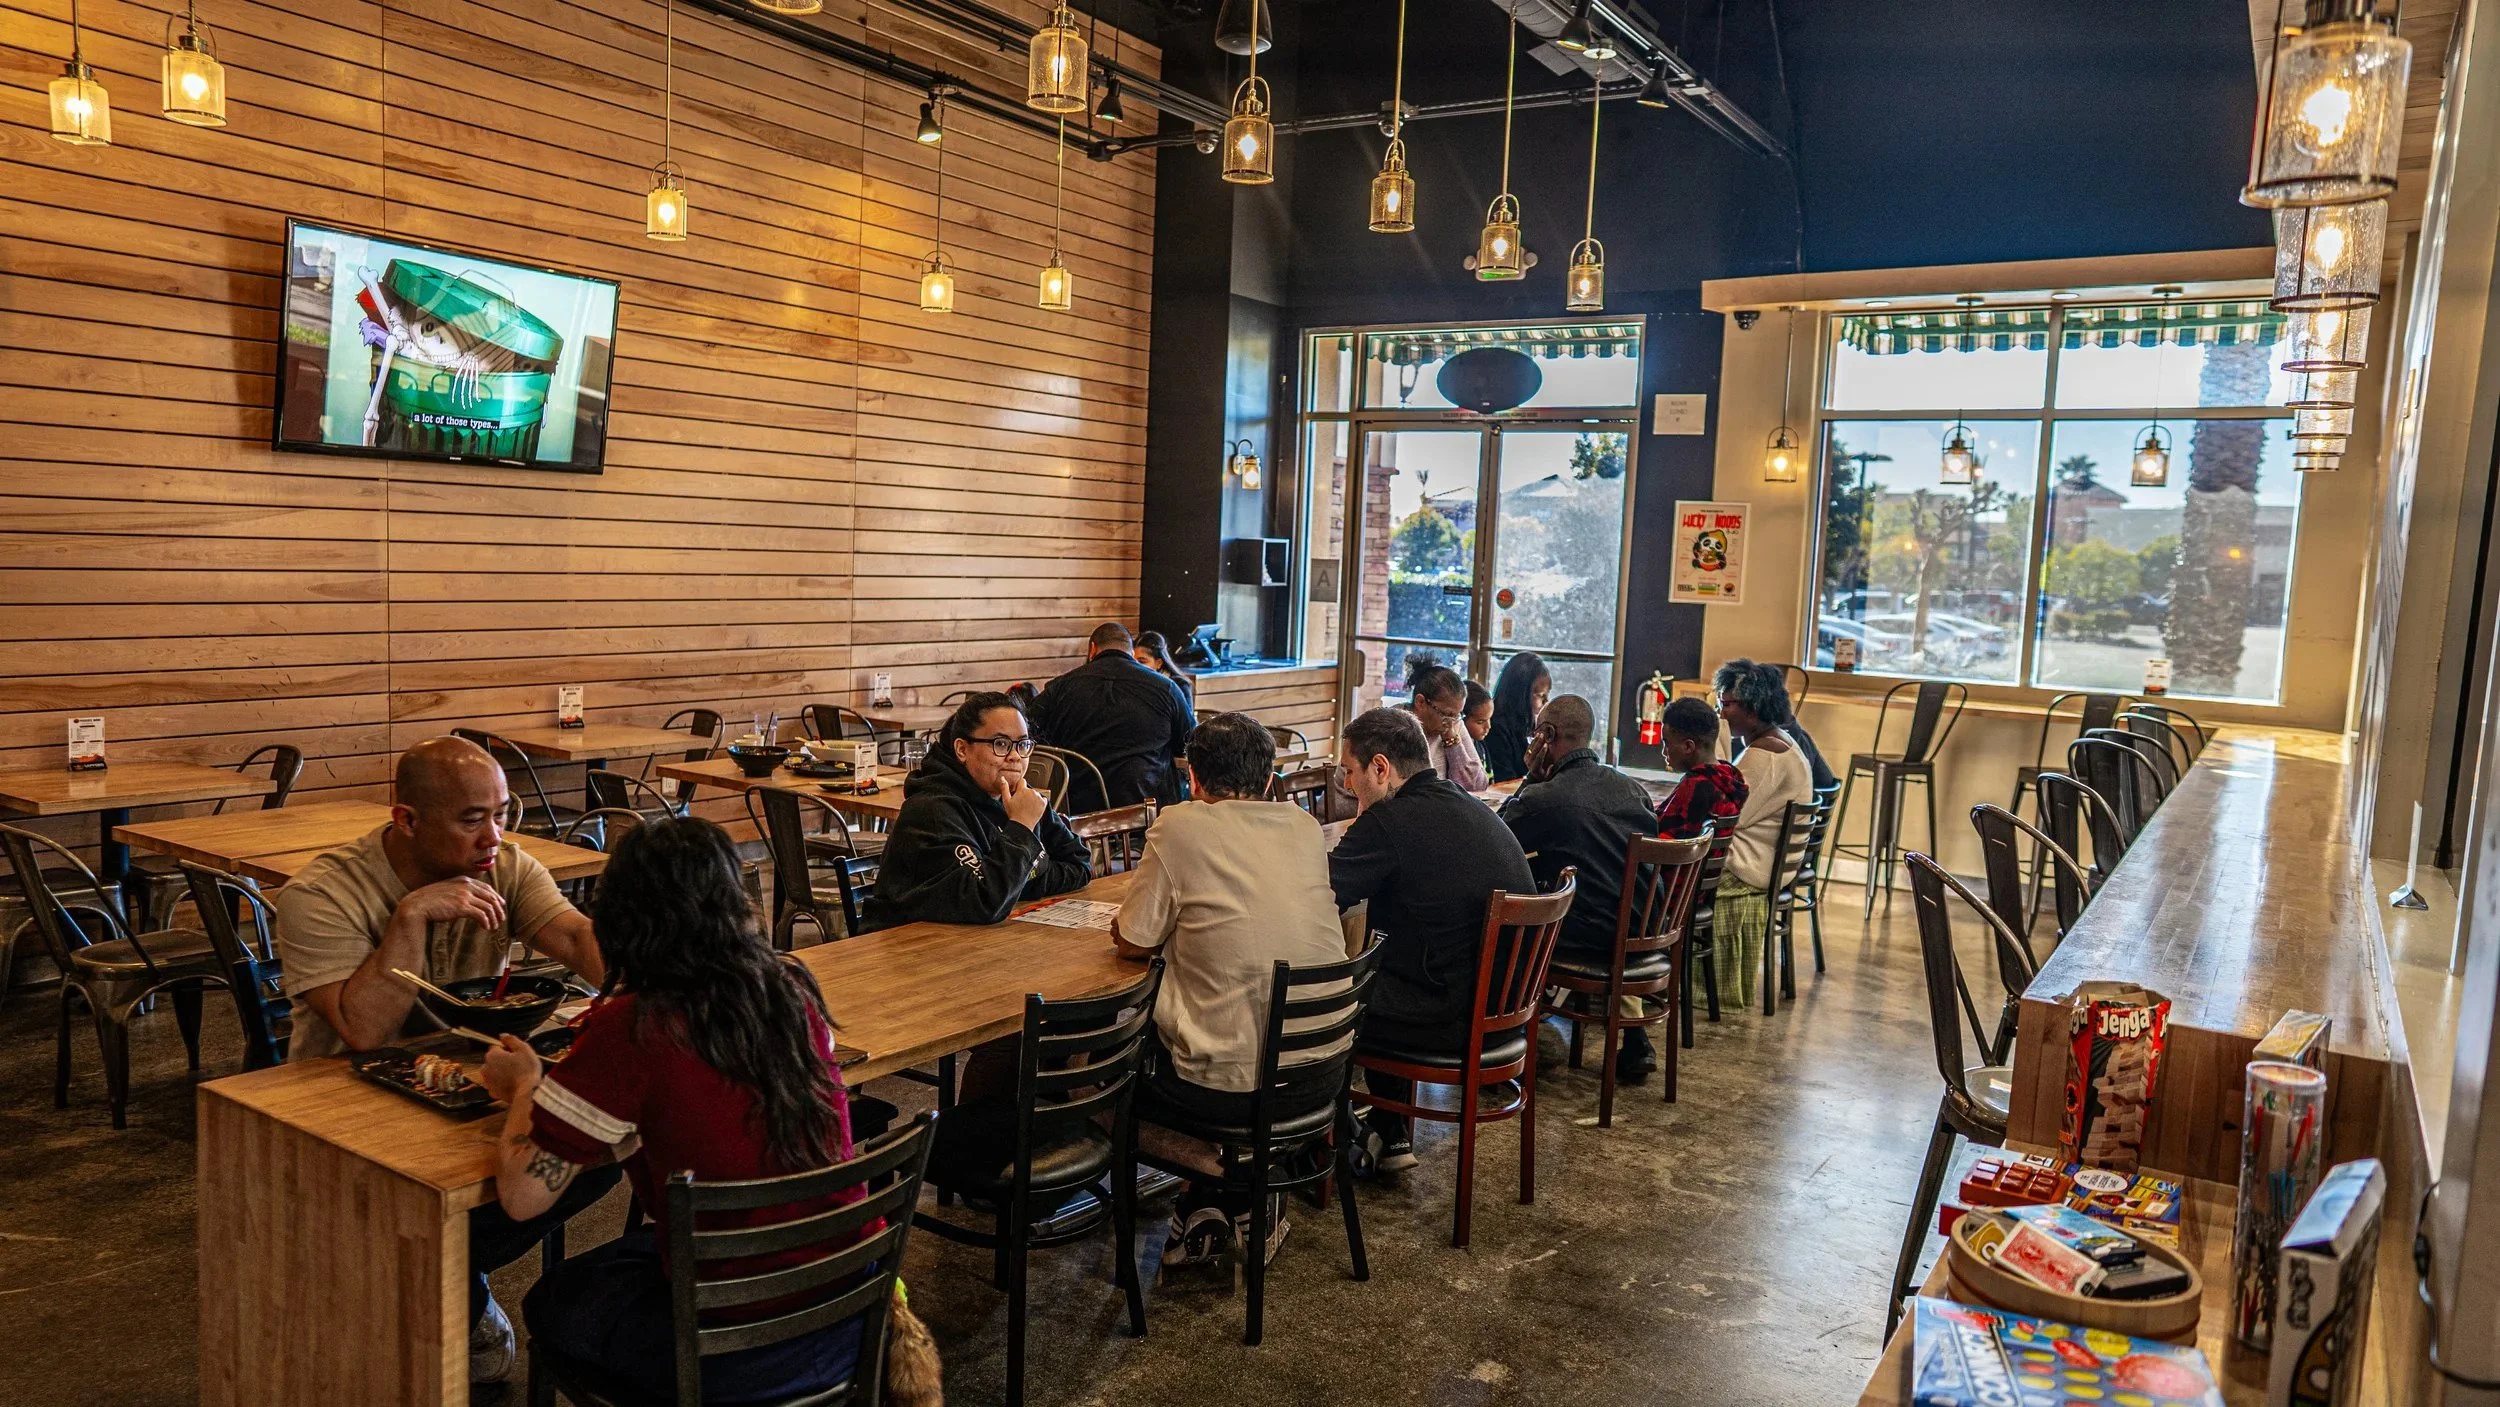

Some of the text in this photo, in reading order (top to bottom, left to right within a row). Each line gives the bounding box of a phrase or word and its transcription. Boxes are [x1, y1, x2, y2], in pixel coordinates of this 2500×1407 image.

[414, 413, 498, 430] a lot of those types...
[1316, 569, 1331, 587] A
[2098, 1007, 2151, 1038] Jenga
